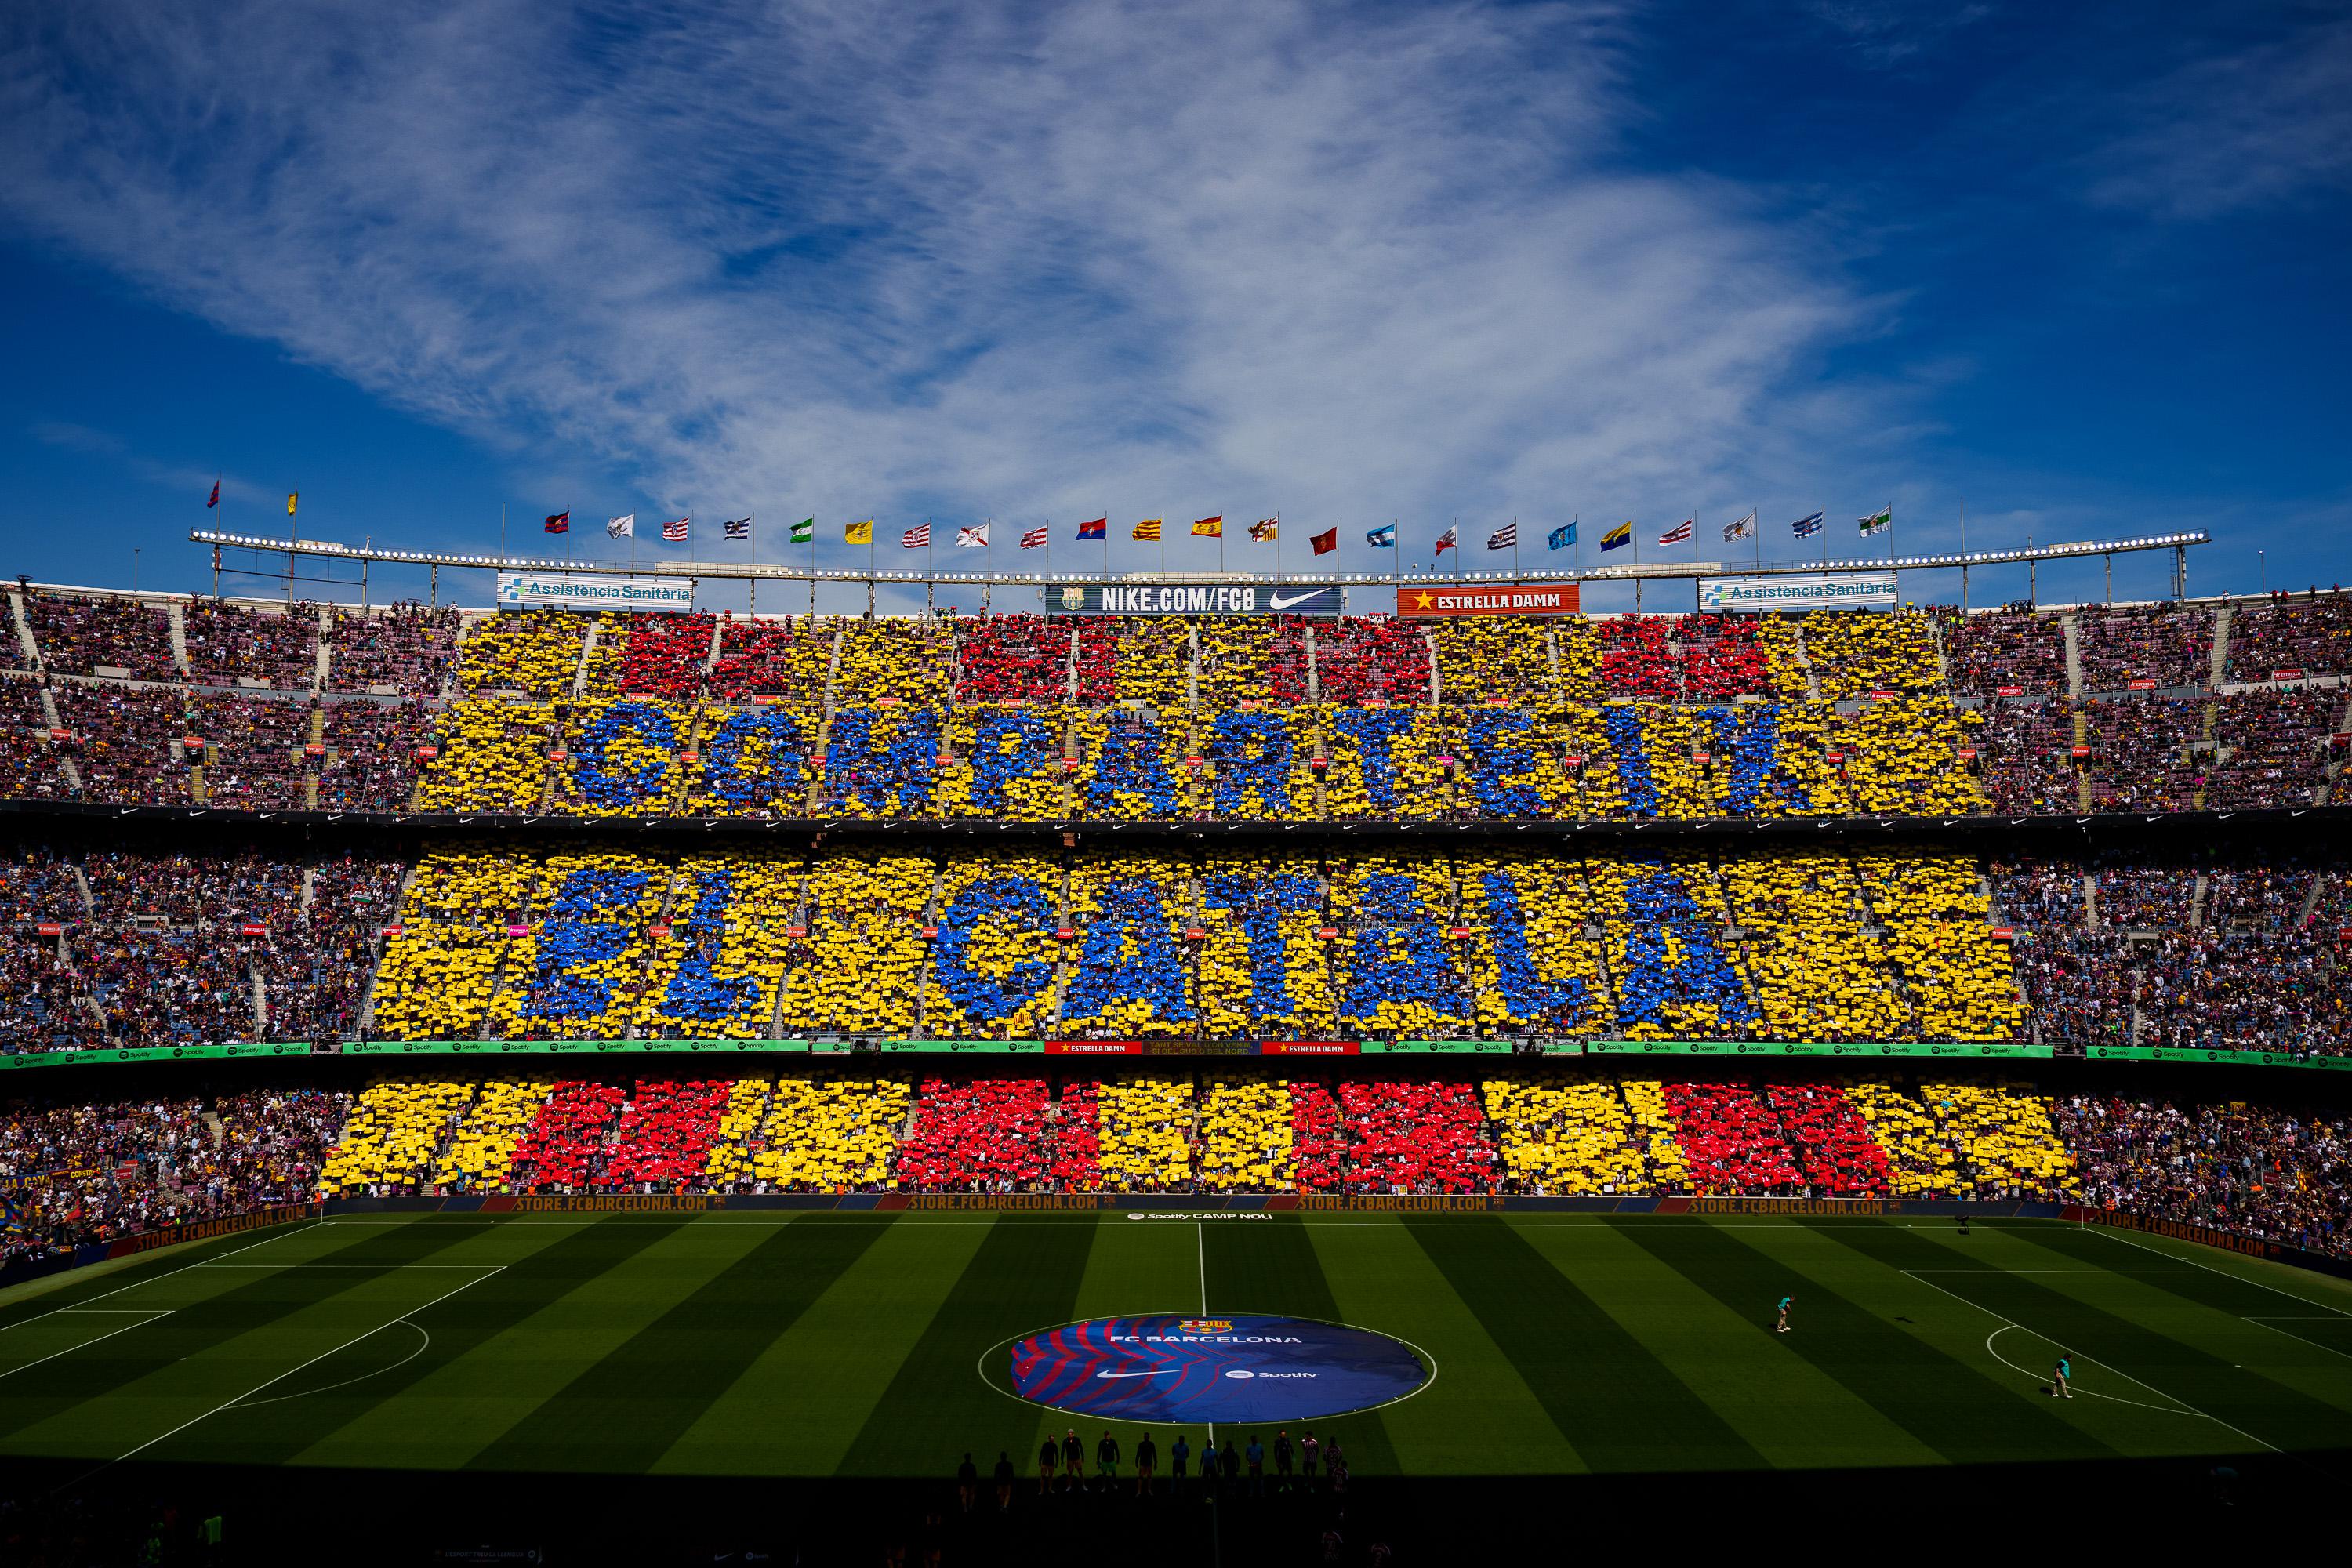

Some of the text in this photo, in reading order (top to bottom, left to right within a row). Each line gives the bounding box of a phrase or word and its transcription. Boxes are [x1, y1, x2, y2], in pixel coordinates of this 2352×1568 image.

[529, 582, 690, 600] Assistència Sanitària
[1731, 582, 1895, 600] Assistència Sanitària
[1102, 588, 1254, 612] NIKE.COM/FCB
[1438, 593, 1560, 609] ESTRELLA DAMM
[517, 1197, 707, 1210] STORE.FCBARCELONA.COM
[911, 1196, 1098, 1210] STORE.FCBARCELONA.COM
[1299, 1196, 1486, 1210] STORE.FCBARCELONA.COM
[1691, 1200, 1882, 1214] STORE.FCBARCELONA.COM
[137, 1204, 306, 1251] STORE.FCBARCELONA.COM
[2096, 1210, 2264, 1257] STORE.FCBARCELONA.COM
